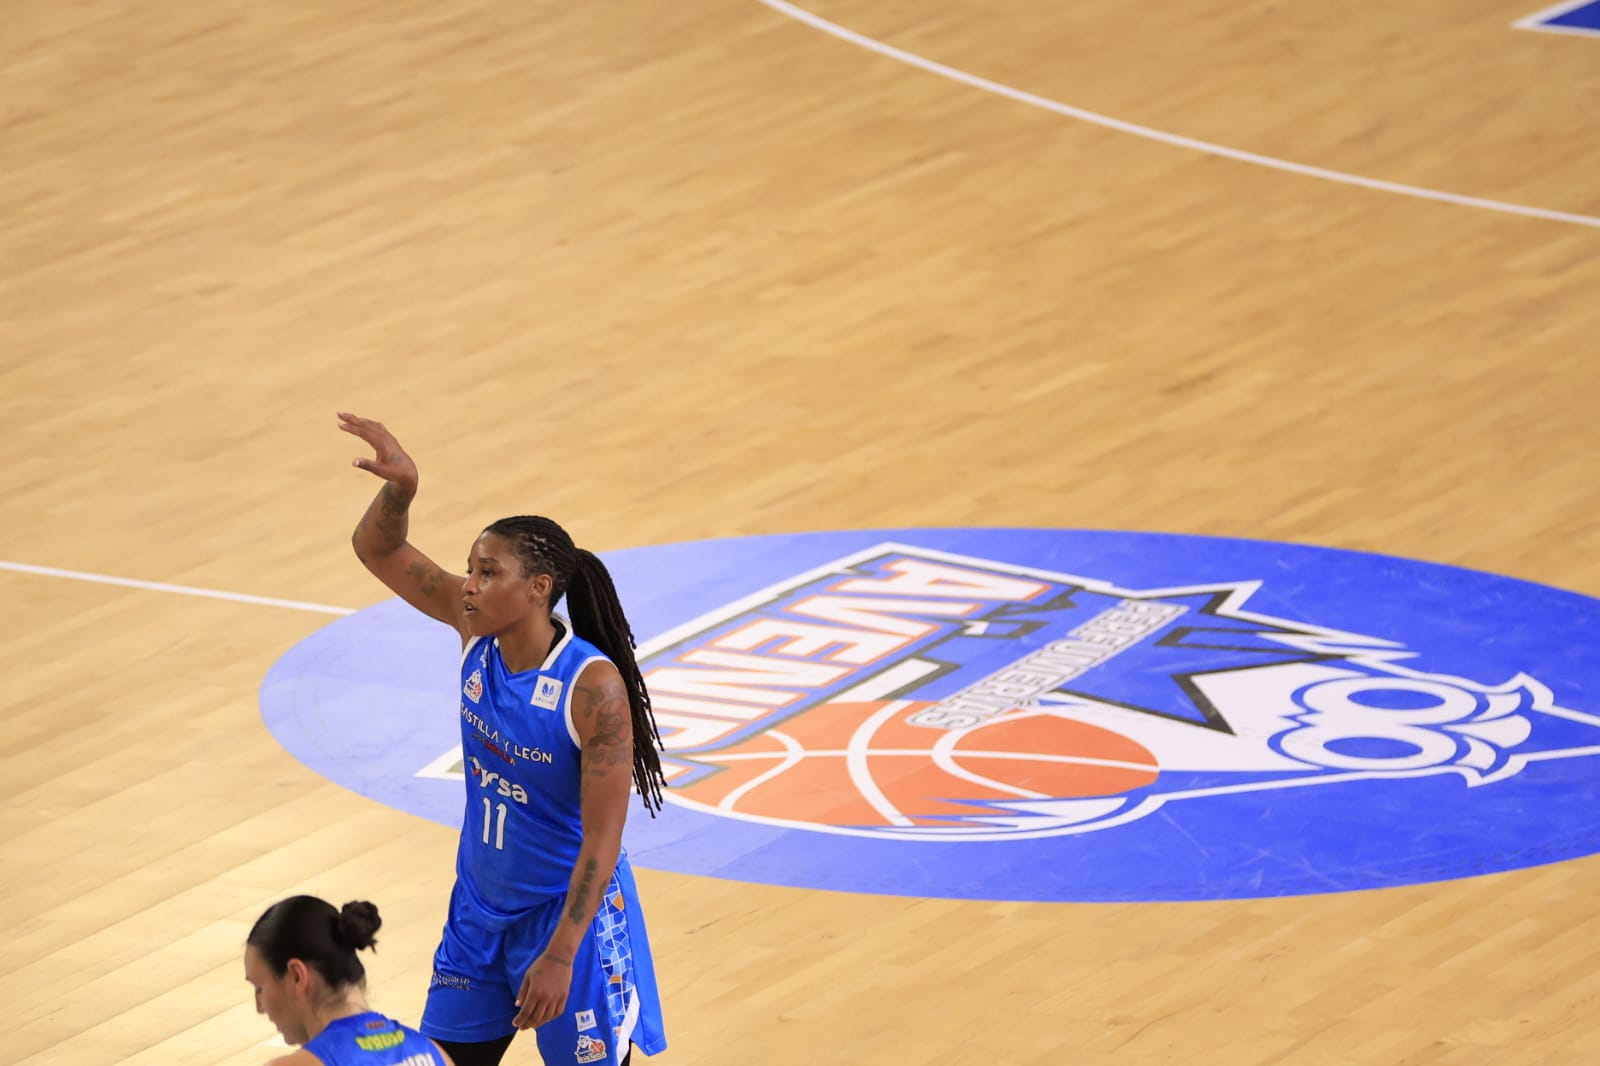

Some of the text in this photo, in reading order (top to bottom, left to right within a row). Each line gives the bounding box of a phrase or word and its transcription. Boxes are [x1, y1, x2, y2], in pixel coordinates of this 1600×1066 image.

[643, 556, 1053, 781] AVENID
[502, 738, 510, 753] Y
[514, 745, 552, 765] LEÓN
[482, 797, 508, 850] 11
